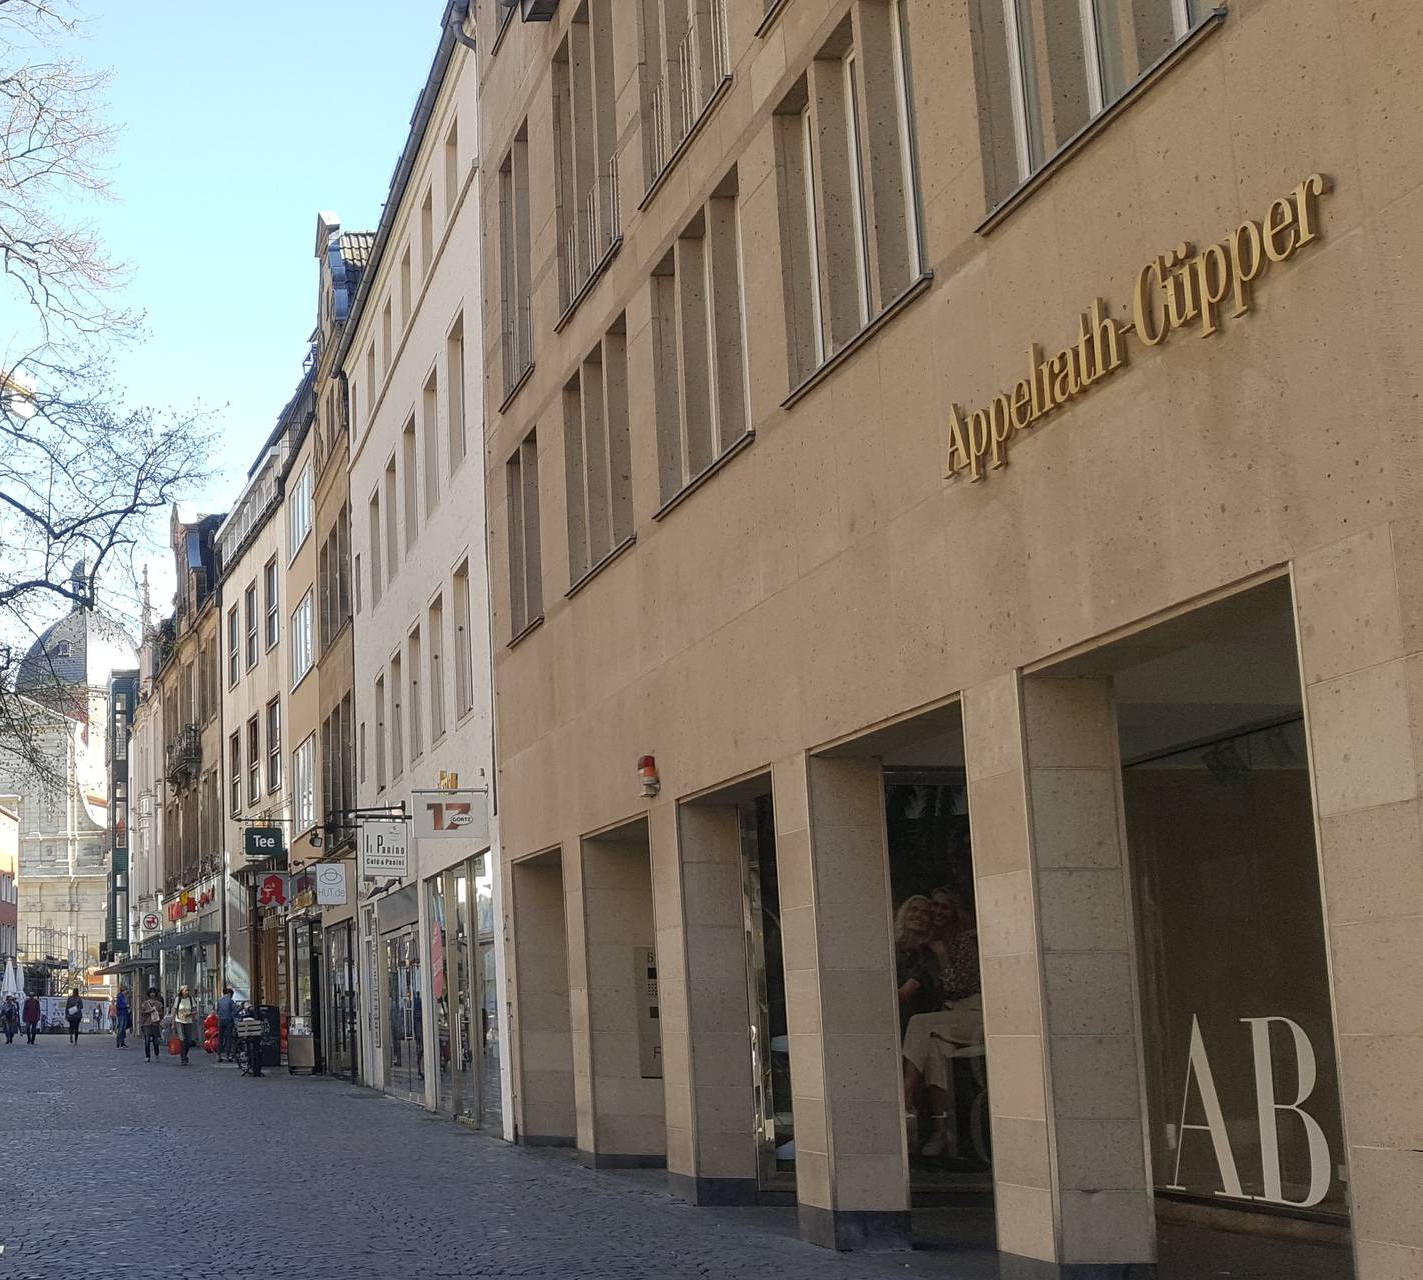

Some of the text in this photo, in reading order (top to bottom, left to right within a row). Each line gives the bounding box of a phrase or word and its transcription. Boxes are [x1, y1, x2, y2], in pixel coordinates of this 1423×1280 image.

[944, 172, 1333, 484] Appelrath-Cüpper
[426, 803, 471, 830] 17
[253, 835, 275, 848] Tee
[377, 834, 405, 855] Panino
[1165, 1012, 1332, 1208] AB
